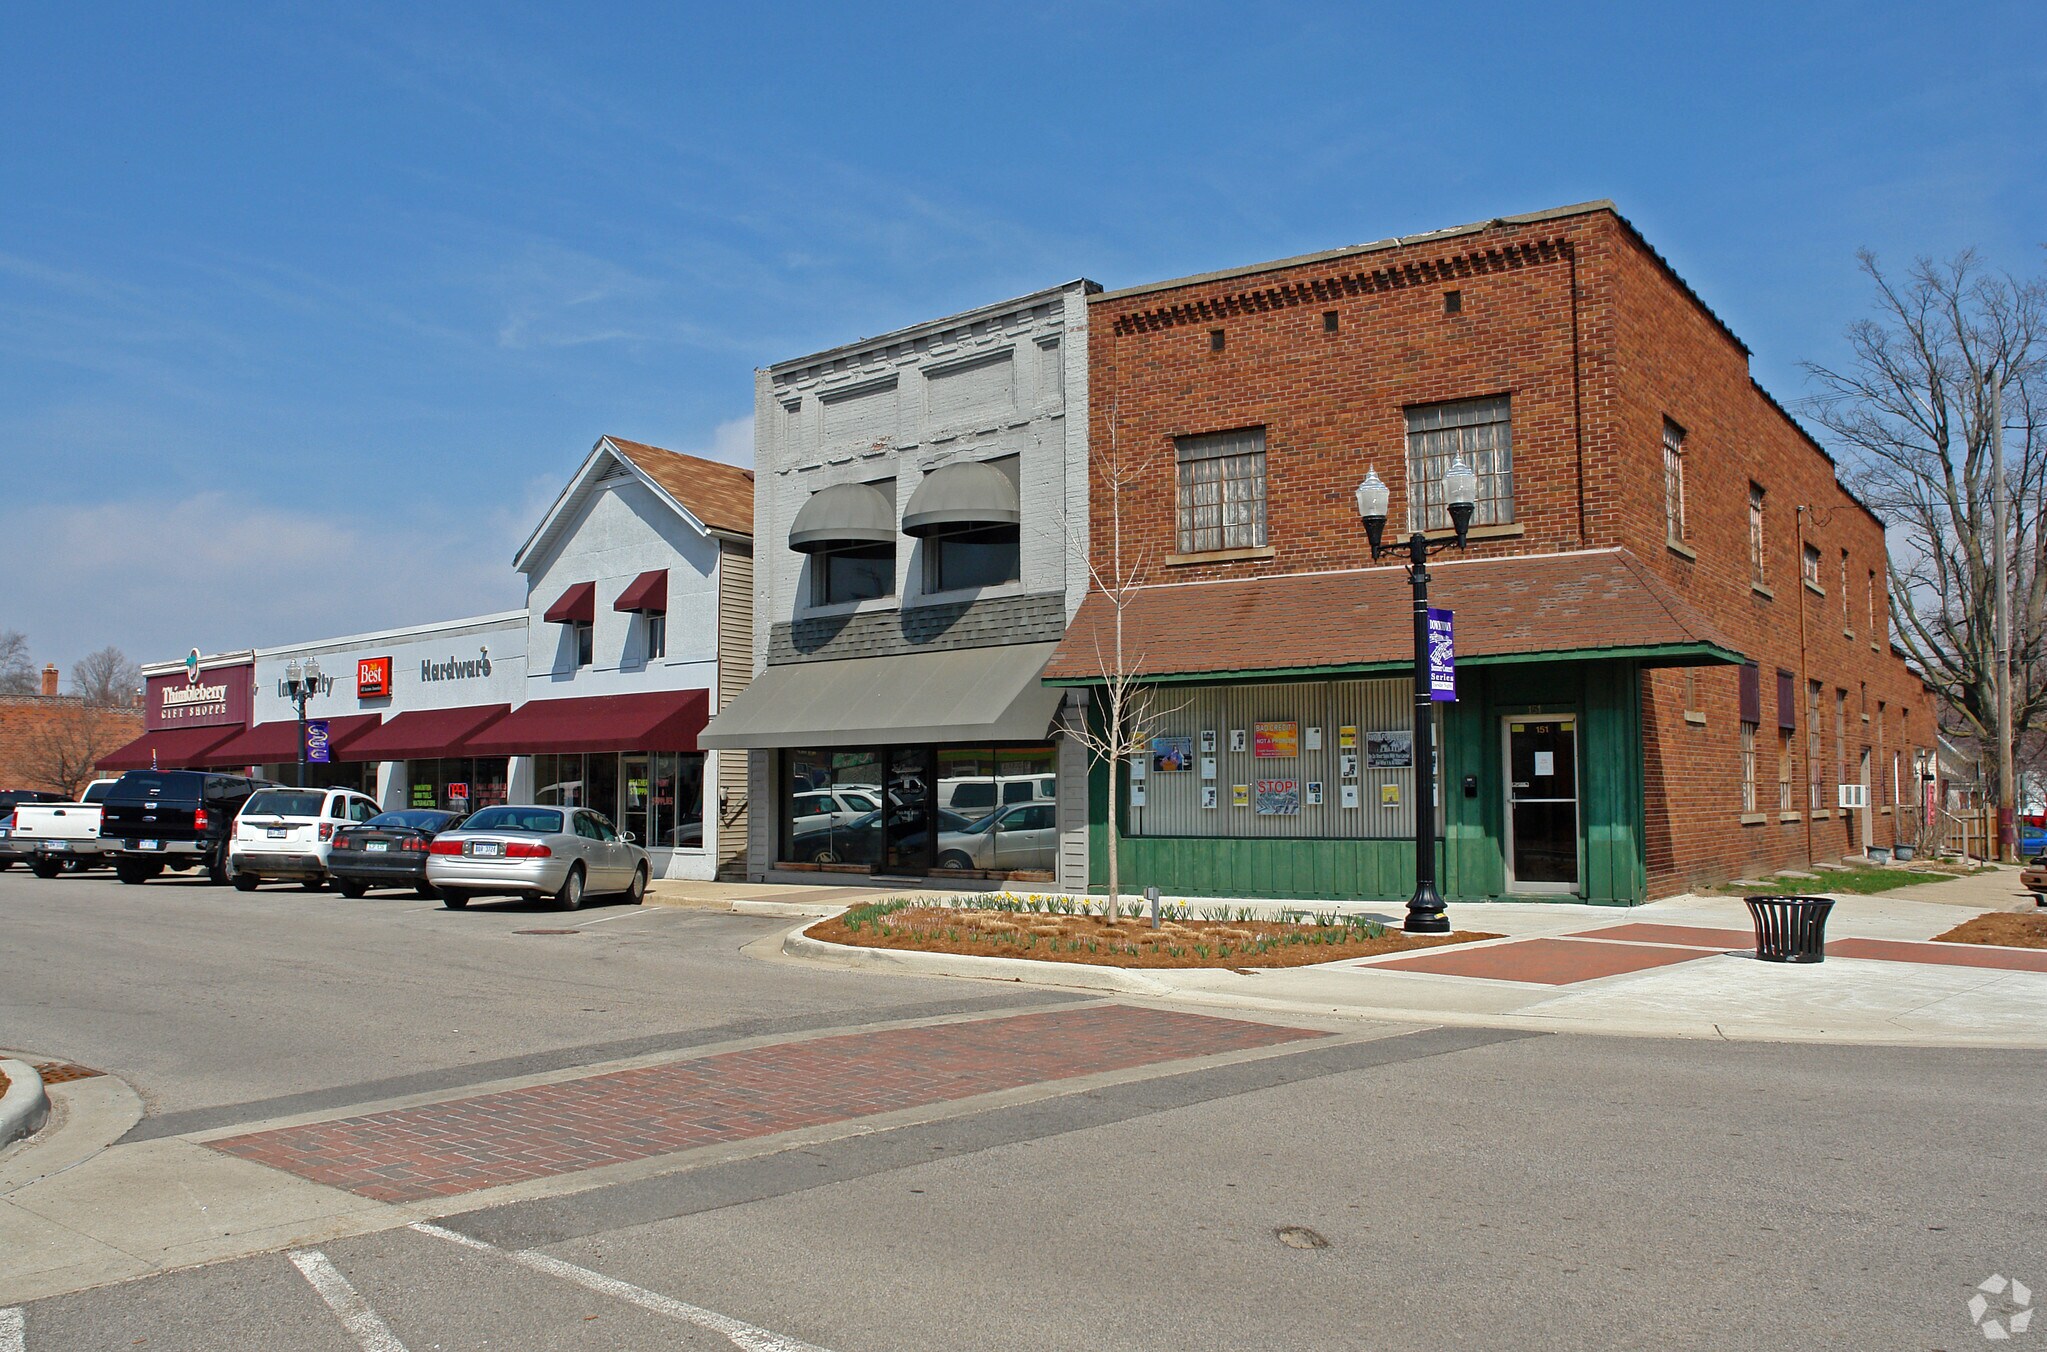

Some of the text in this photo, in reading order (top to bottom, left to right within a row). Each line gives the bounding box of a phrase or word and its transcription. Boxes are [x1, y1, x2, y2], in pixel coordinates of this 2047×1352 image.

[361, 664, 382, 683] Best
[421, 656, 492, 682] Hardware
[1431, 673, 1453, 681] Series
[162, 683, 227, 704] Thimbleberry
[162, 704, 226, 719] GIFT SHOPPE
[1255, 723, 1296, 732] BAD CREDIT?
[1536, 726, 1549, 734] 151
[1258, 781, 1297, 793] STOP!
